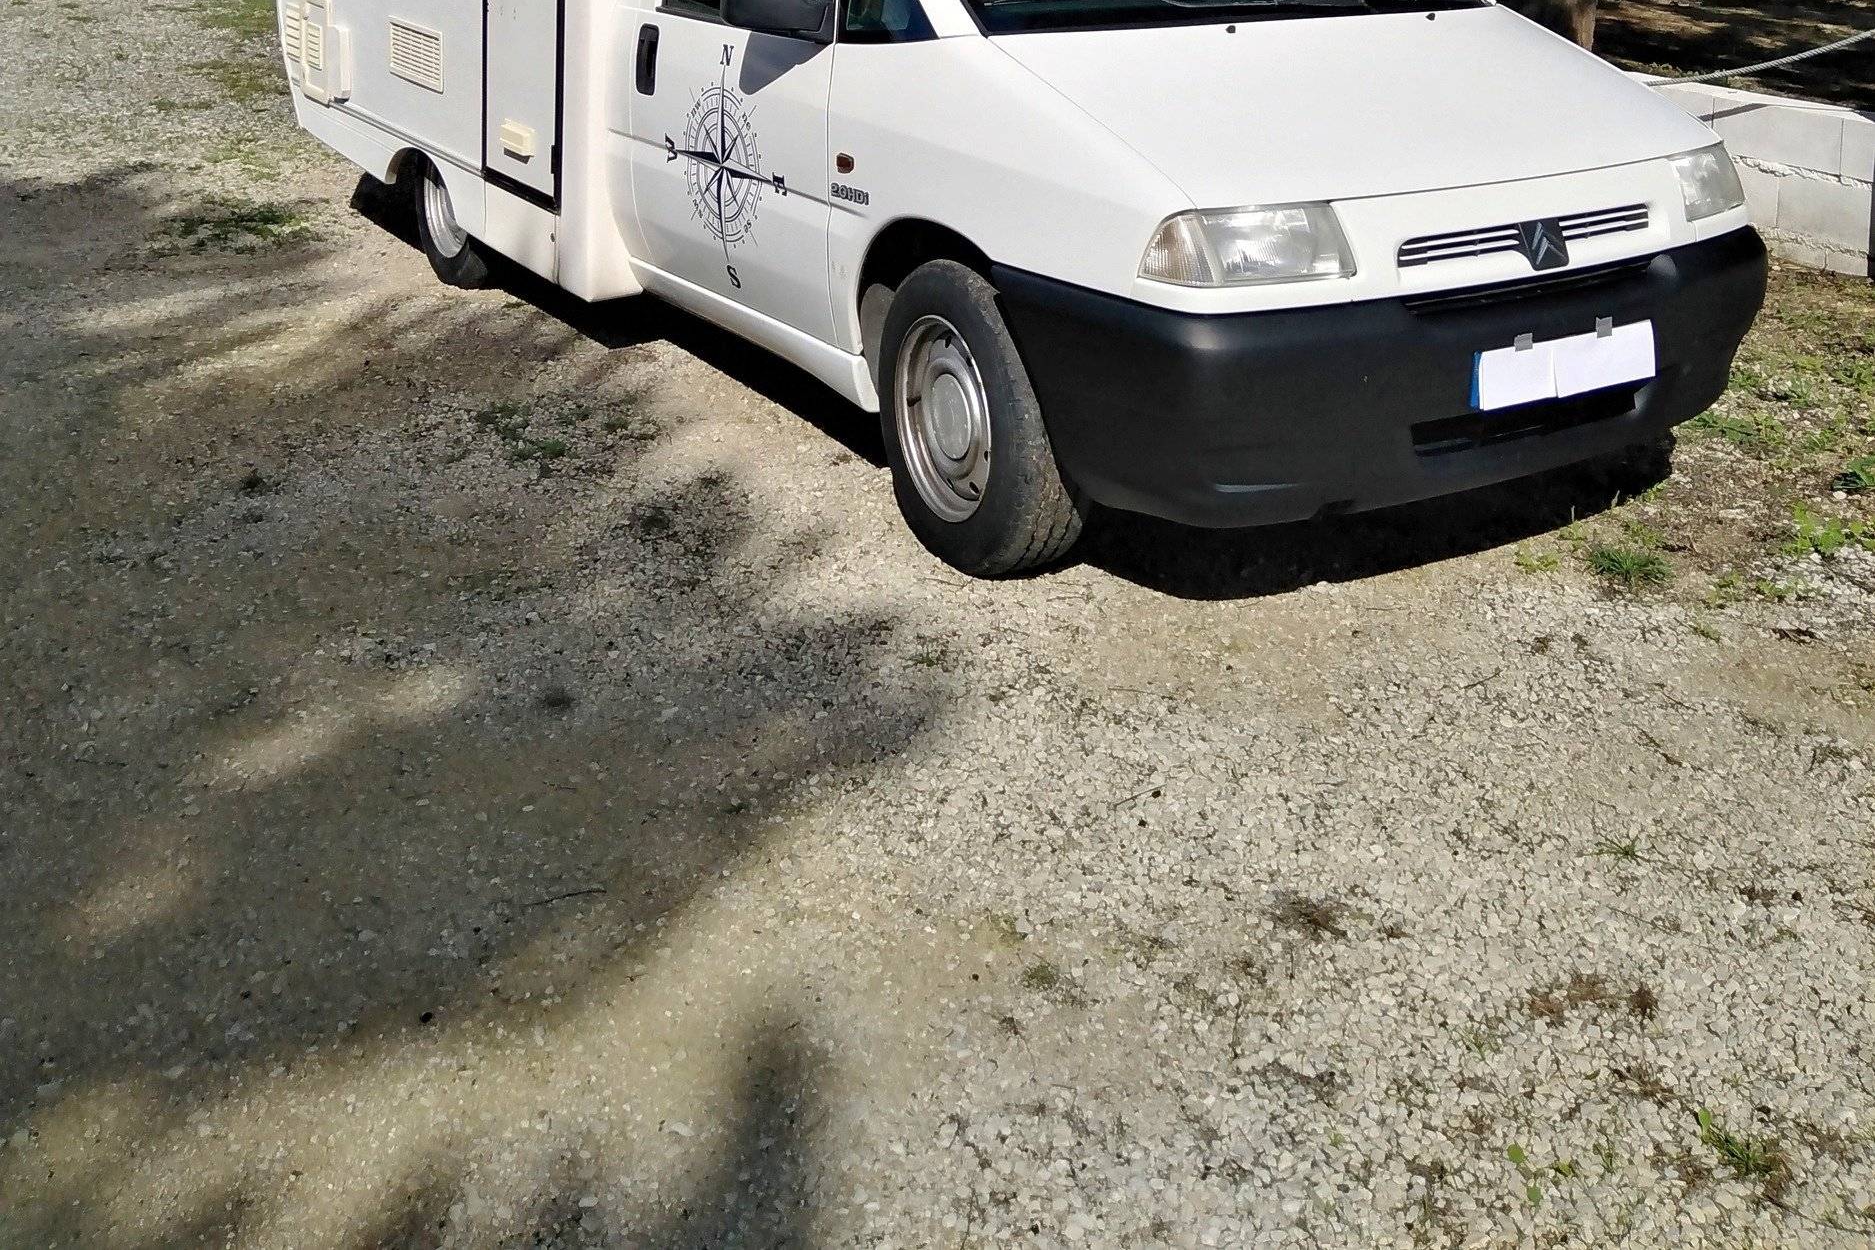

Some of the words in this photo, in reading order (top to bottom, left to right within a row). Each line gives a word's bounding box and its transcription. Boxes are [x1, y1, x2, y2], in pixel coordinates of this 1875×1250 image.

[720, 44, 734, 66] N
[664, 133, 677, 163] W
[772, 172, 787, 196] E
[726, 265, 741, 289] S
